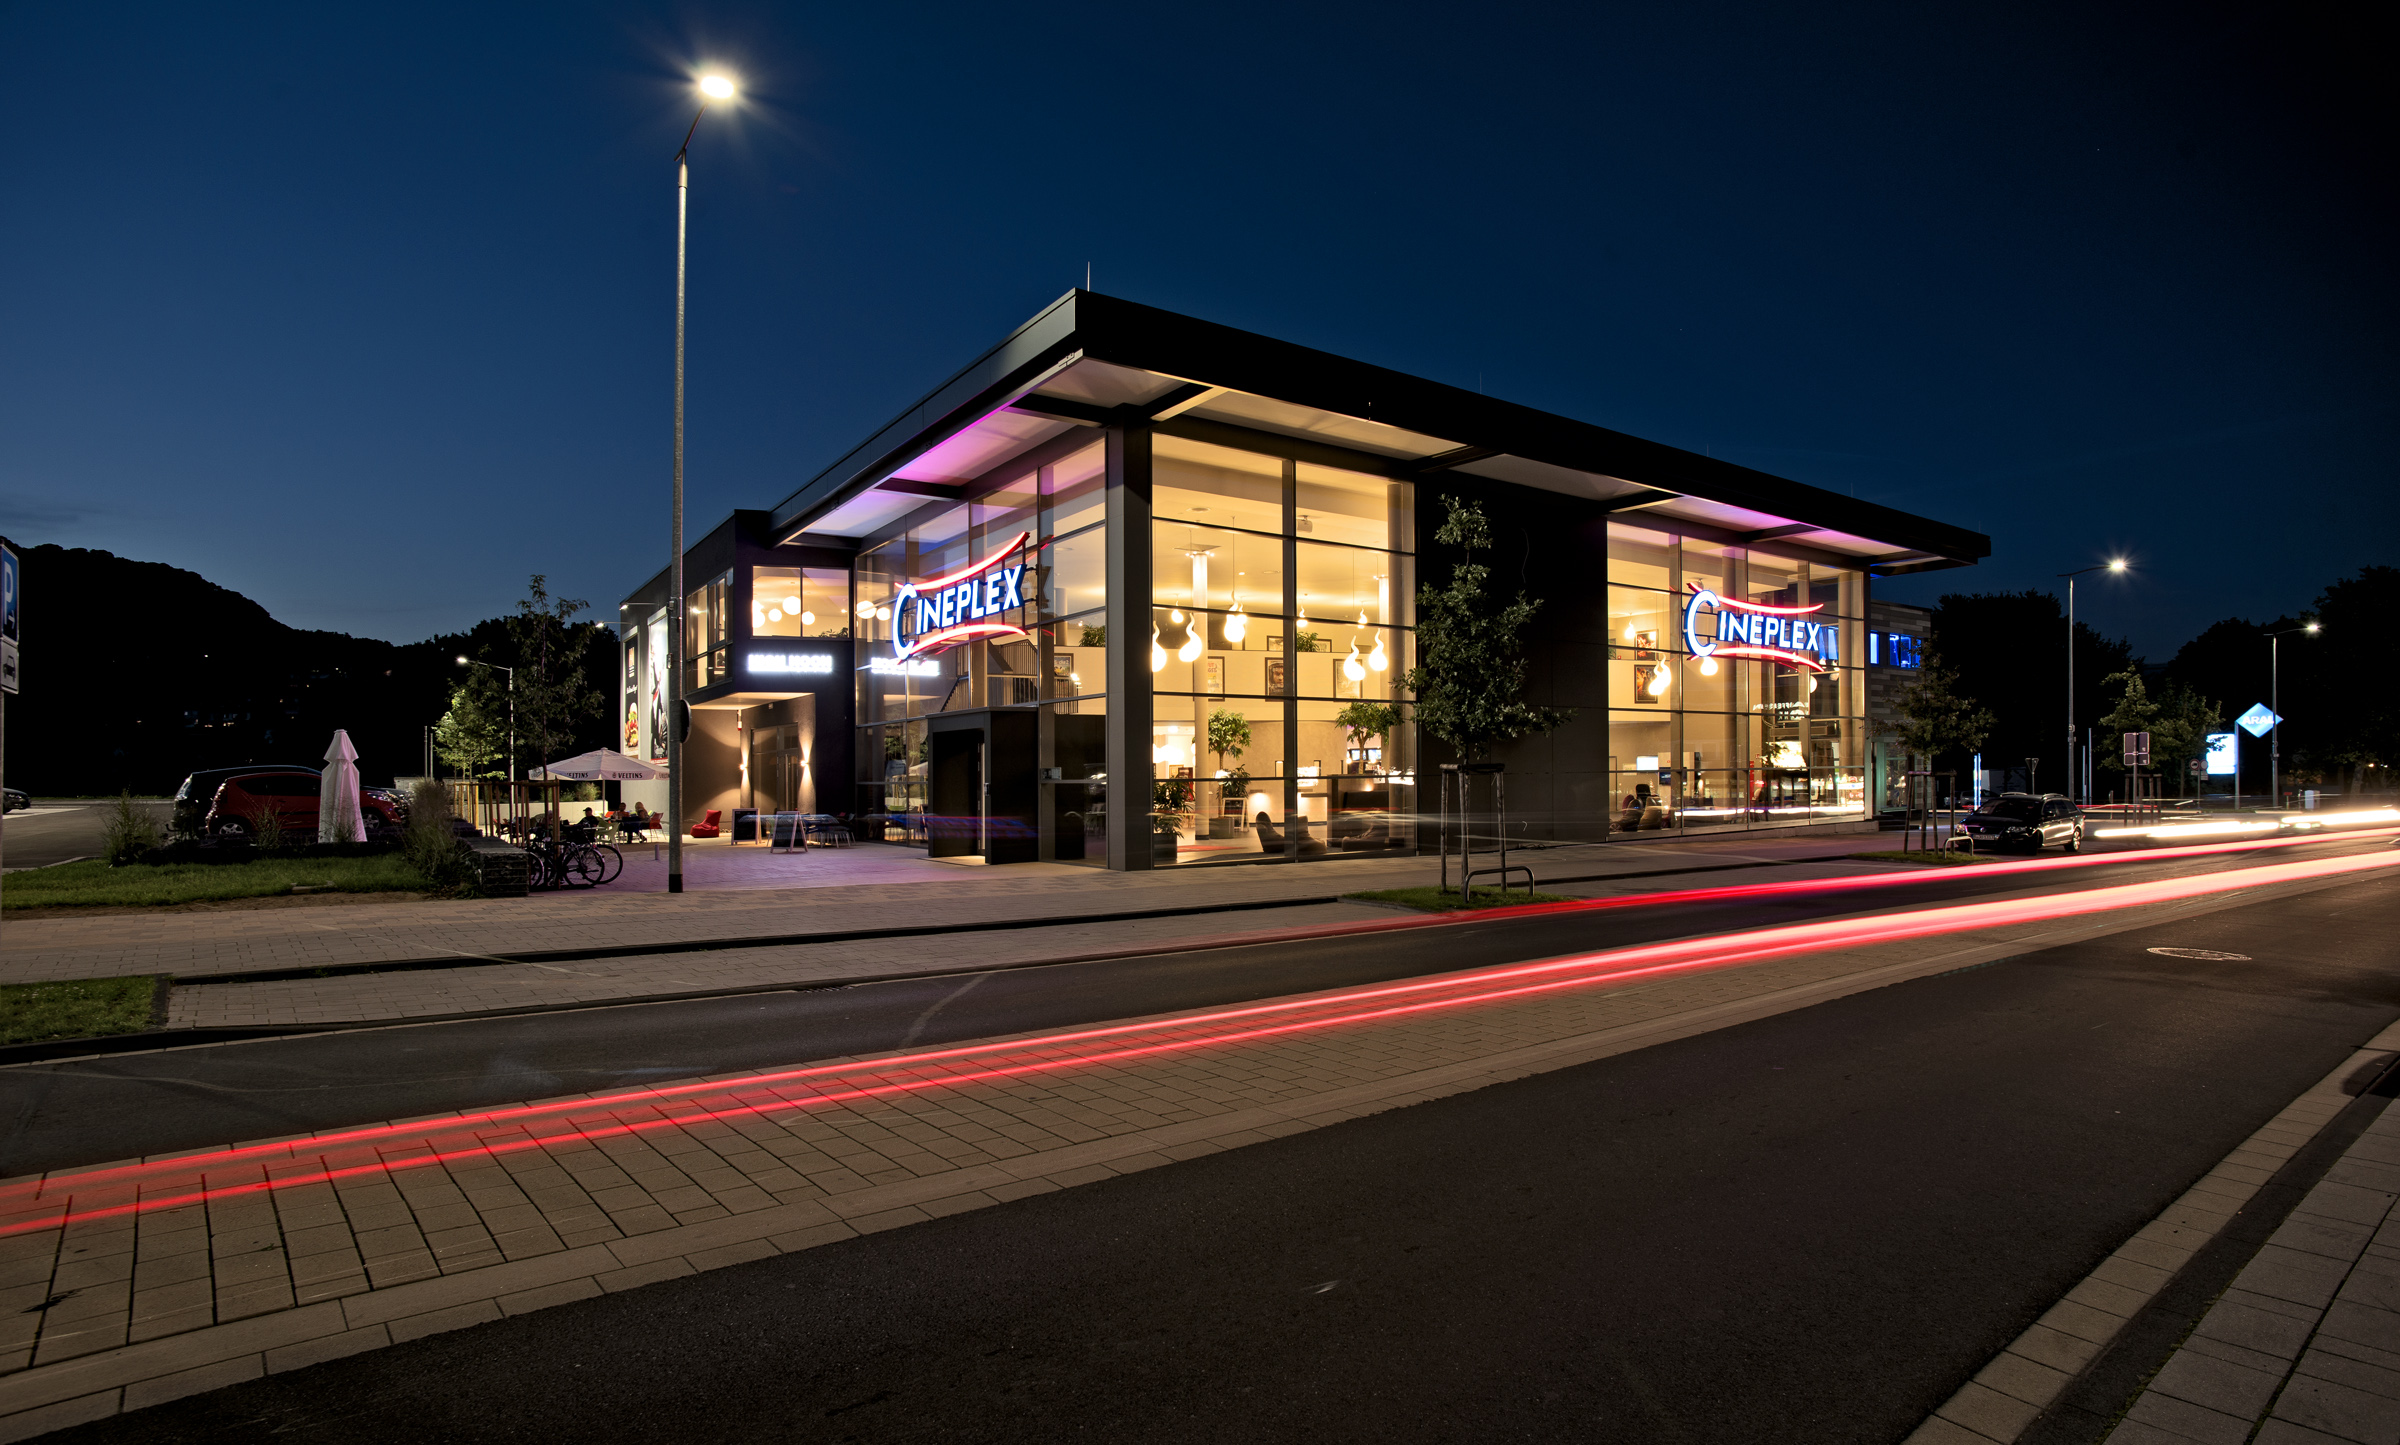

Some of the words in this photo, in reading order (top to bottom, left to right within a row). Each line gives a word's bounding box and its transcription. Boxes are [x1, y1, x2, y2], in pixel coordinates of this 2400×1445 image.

[4, 561, 13, 625] P
[892, 563, 1026, 661] CINEPLEX
[1685, 589, 1821, 657] CINEPLEX
[2241, 715, 2274, 725] ARAL
